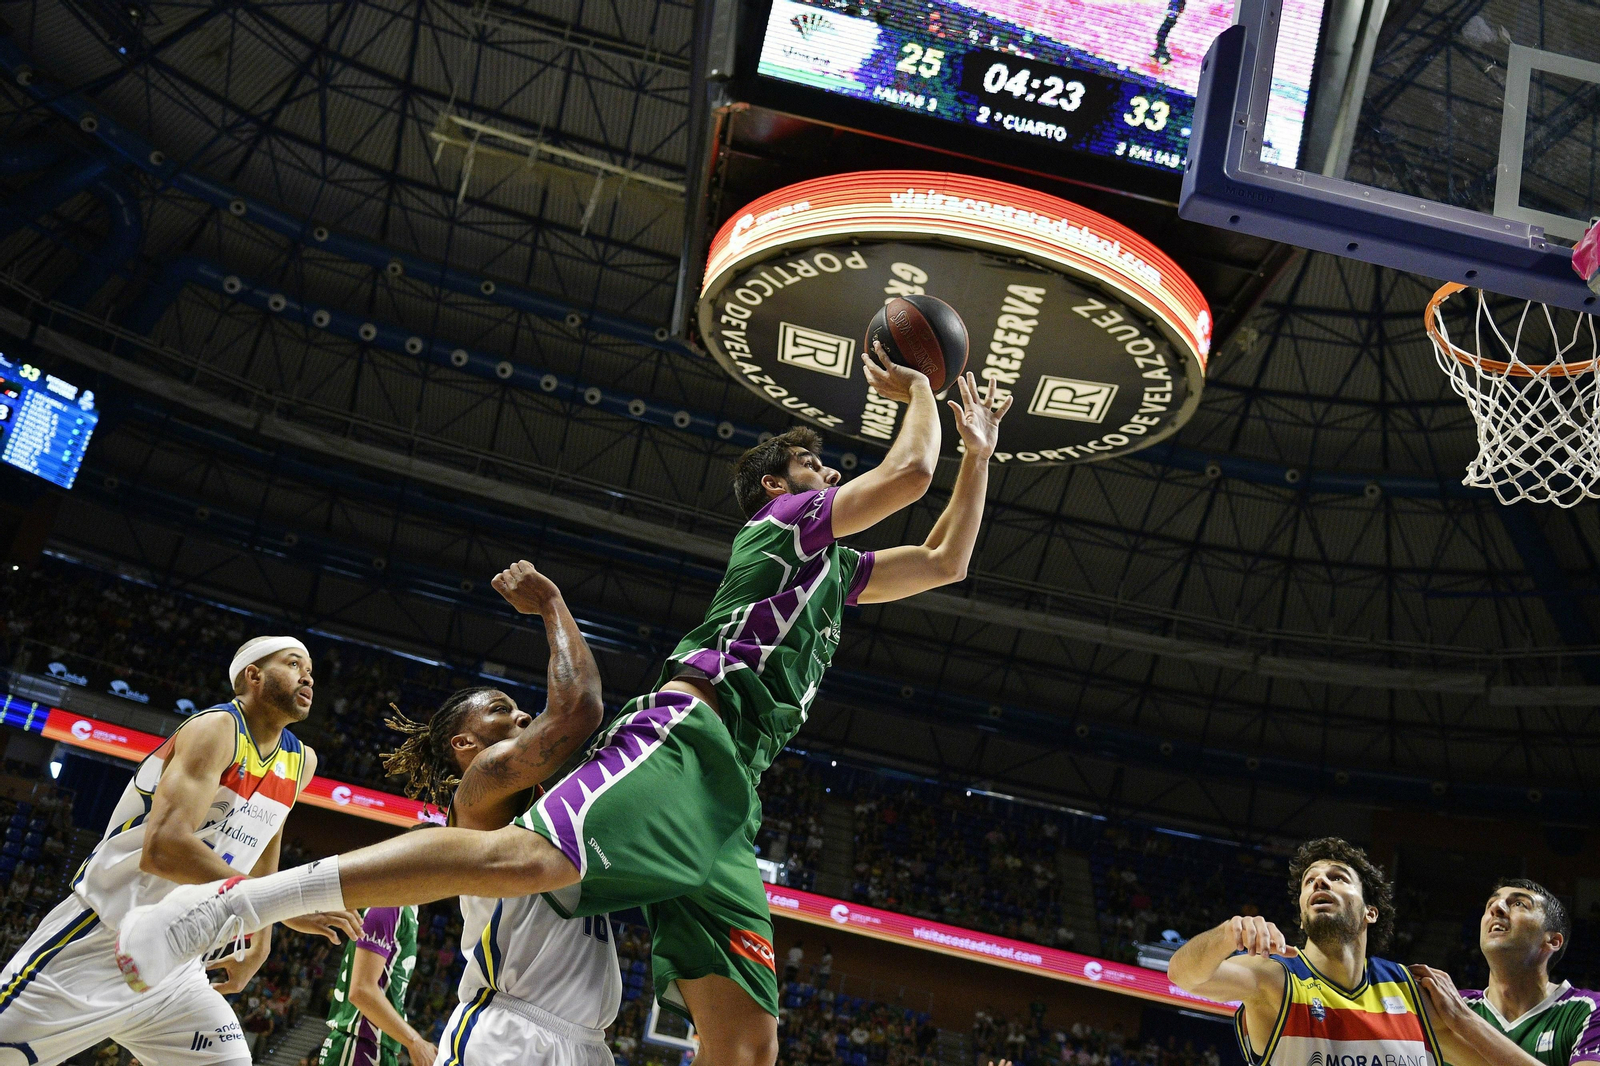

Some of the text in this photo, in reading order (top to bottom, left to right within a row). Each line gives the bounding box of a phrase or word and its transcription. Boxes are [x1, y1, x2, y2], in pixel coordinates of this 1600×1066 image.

[896, 42, 945, 78] 25
[983, 63, 1086, 111] 04:23
[1002, 115, 1067, 142] CUARTO
[1123, 96, 1170, 132] 33
[735, 251, 868, 306] PORTICO
[981, 284, 1046, 384] RESERVA
[996, 432, 1130, 463] PORTICO
[1071, 298, 1173, 414] VELAZQUEZ
[588, 837, 612, 870] SPALDING
